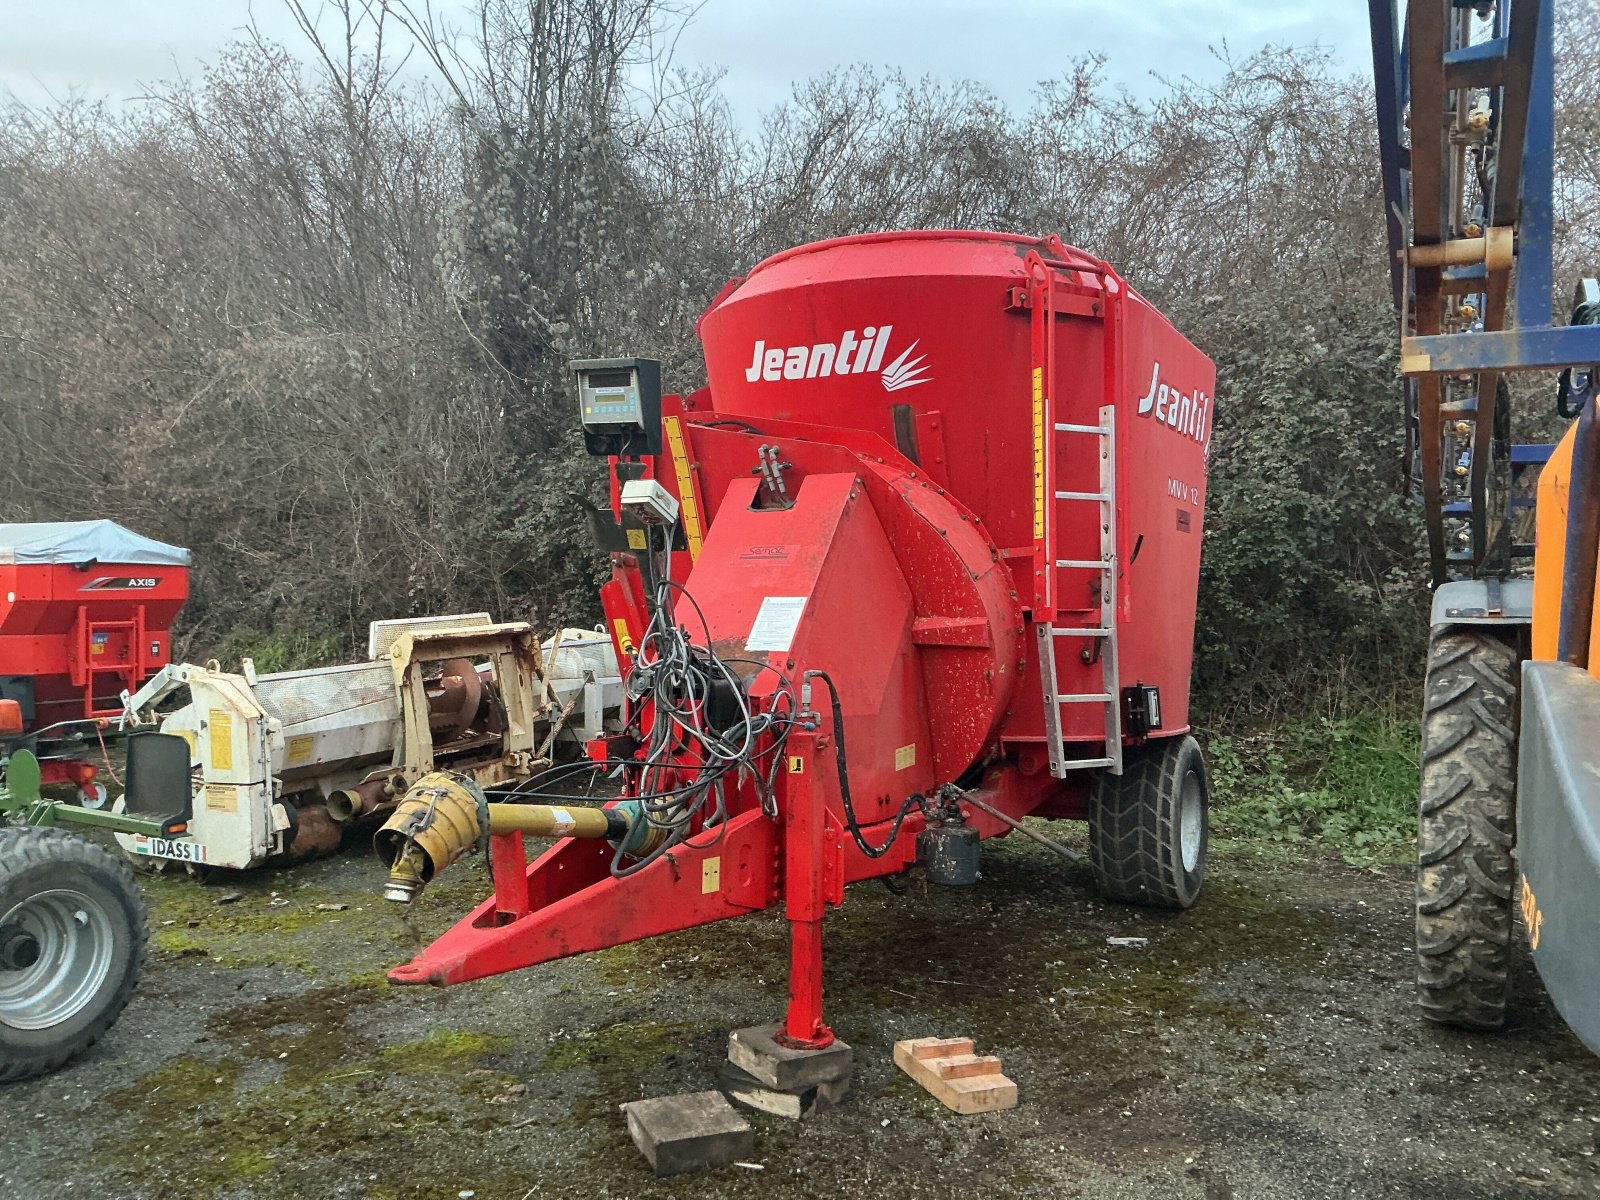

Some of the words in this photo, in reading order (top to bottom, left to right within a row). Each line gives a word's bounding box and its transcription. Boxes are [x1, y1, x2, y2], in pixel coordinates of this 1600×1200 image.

[745, 325, 893, 382] Jeantil
[1138, 361, 1208, 442] Jeantil
[1190, 487, 1198, 506] 12
[128, 578, 156, 587] AXIS
[152, 839, 191, 859] IDASS
